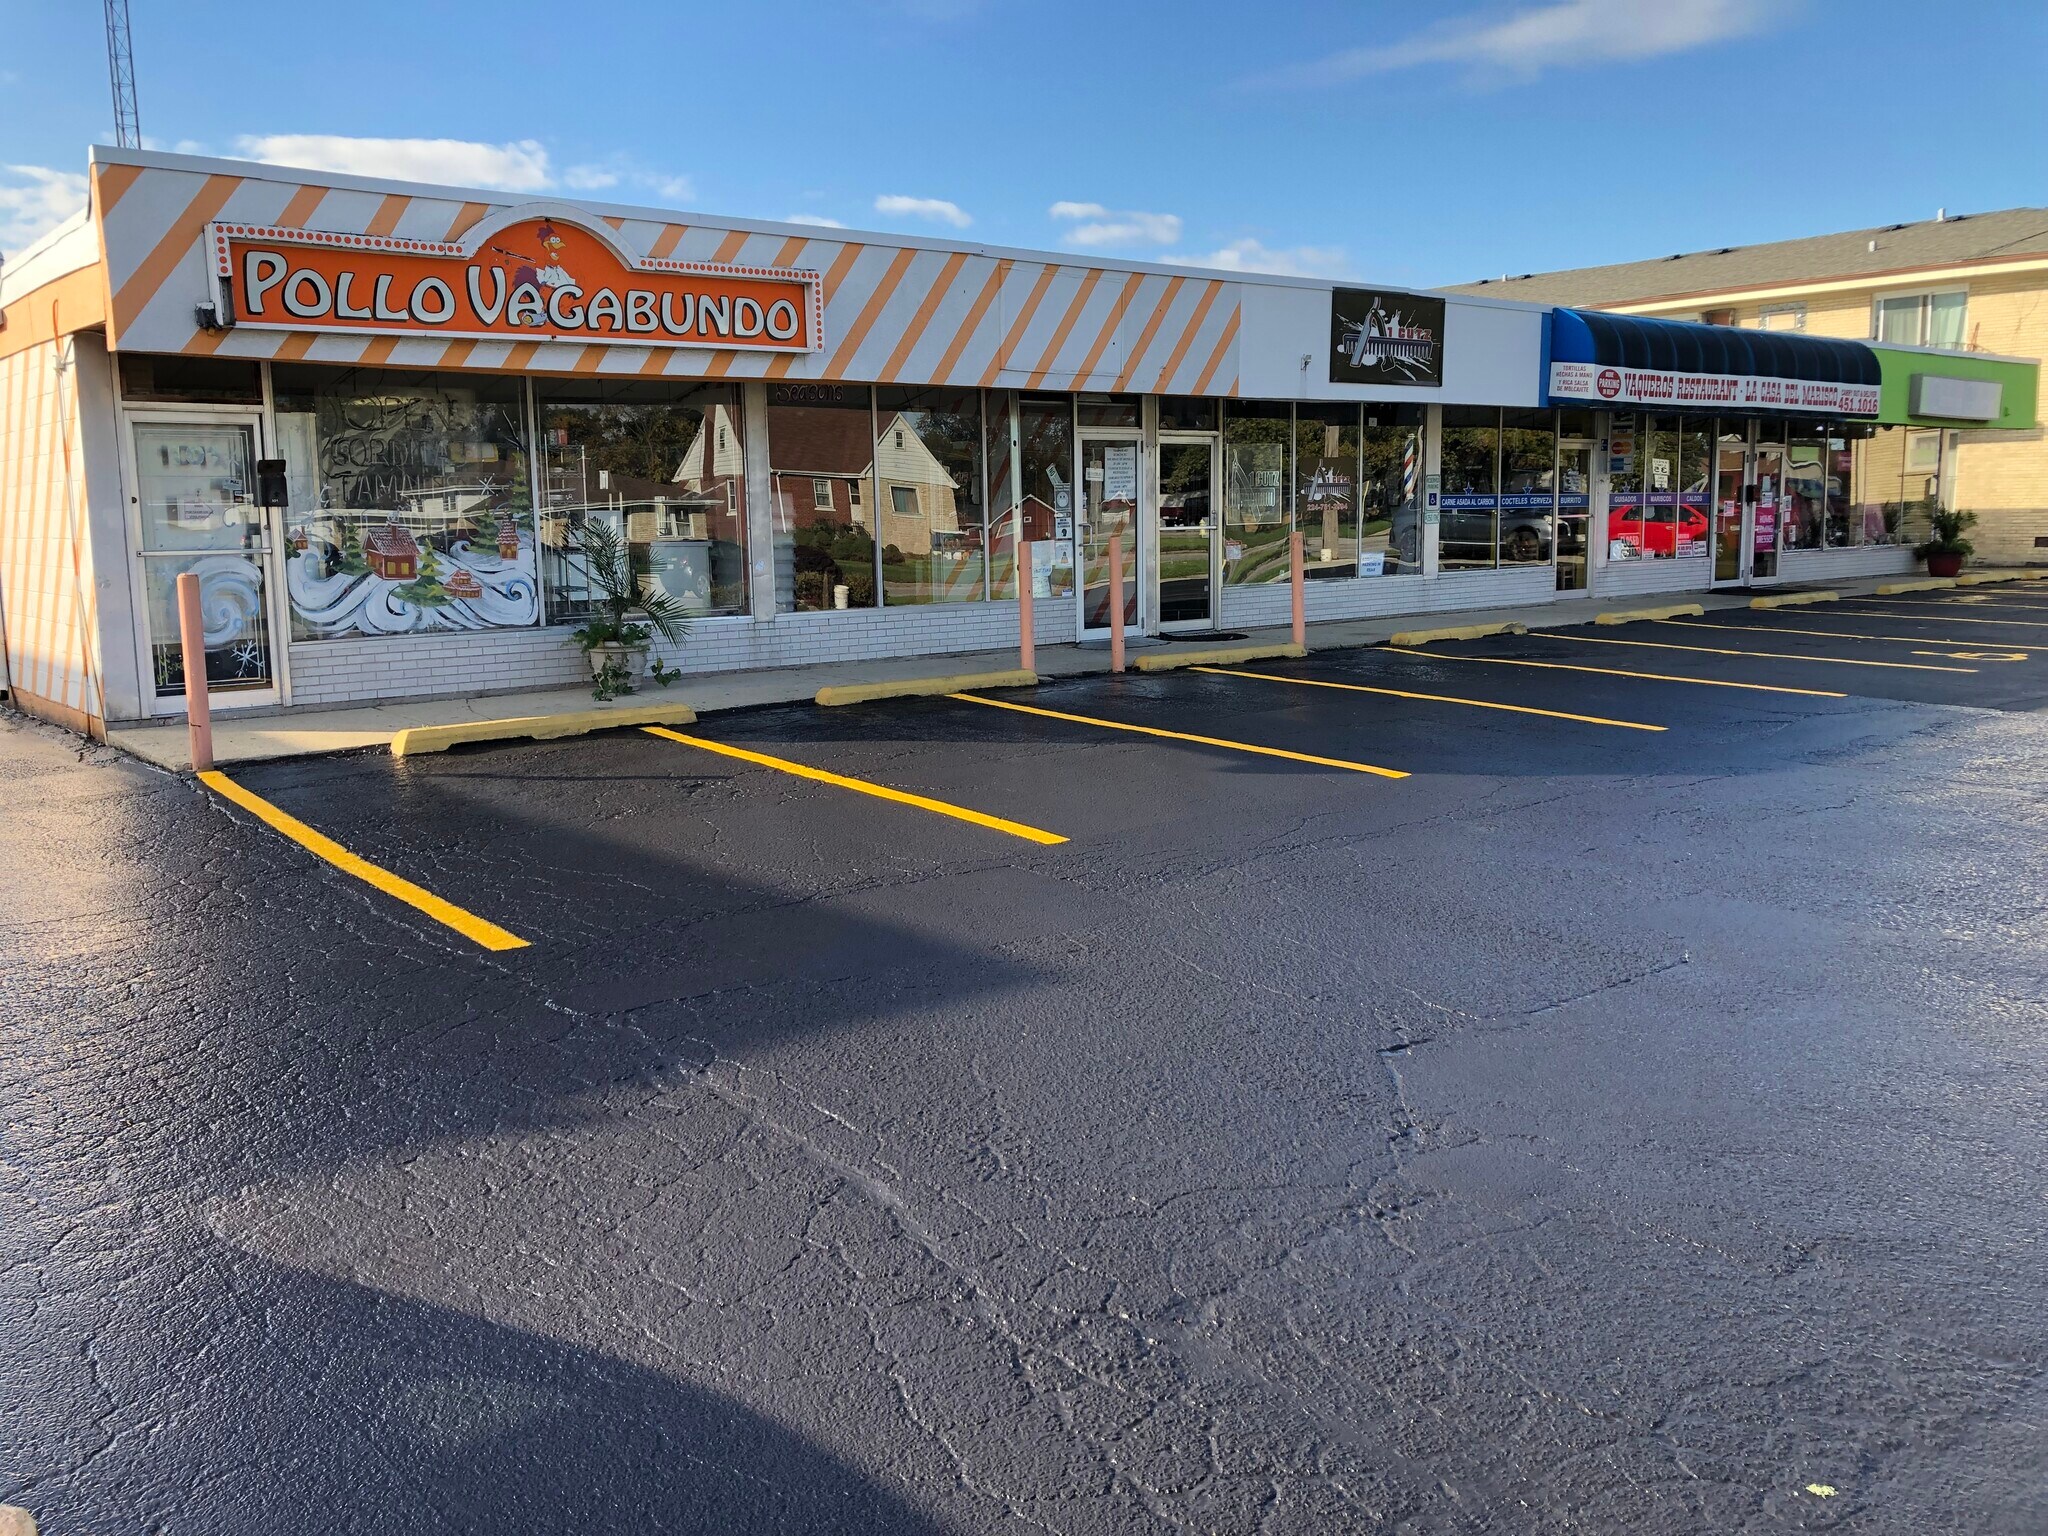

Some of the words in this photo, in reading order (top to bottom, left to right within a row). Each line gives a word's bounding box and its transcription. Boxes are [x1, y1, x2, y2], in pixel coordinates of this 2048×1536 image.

[243, 249, 455, 326] POLLO
[465, 264, 800, 342] VAGABUNDO
[1398, 327, 1432, 341] CUTZ
[775, 382, 844, 402] Seasons
[1599, 378, 1620, 389] PARKING
[1624, 373, 1673, 401] VAQUEROS
[1677, 377, 1739, 401] RESTAURANT
[1745, 380, 1757, 402] LA
[1761, 381, 1782, 403] CASA
[1784, 383, 1799, 405] DEL
[1802, 385, 1839, 407] MARISCO
[1838, 396, 1878, 413] 451.1016
[1255, 470, 1280, 487] CUTZ
[1471, 498, 1477, 506] AL
[1477, 498, 1495, 506] CARBON
[1501, 497, 1528, 505] COCTELES
[1529, 497, 1553, 505] CERVEZA
